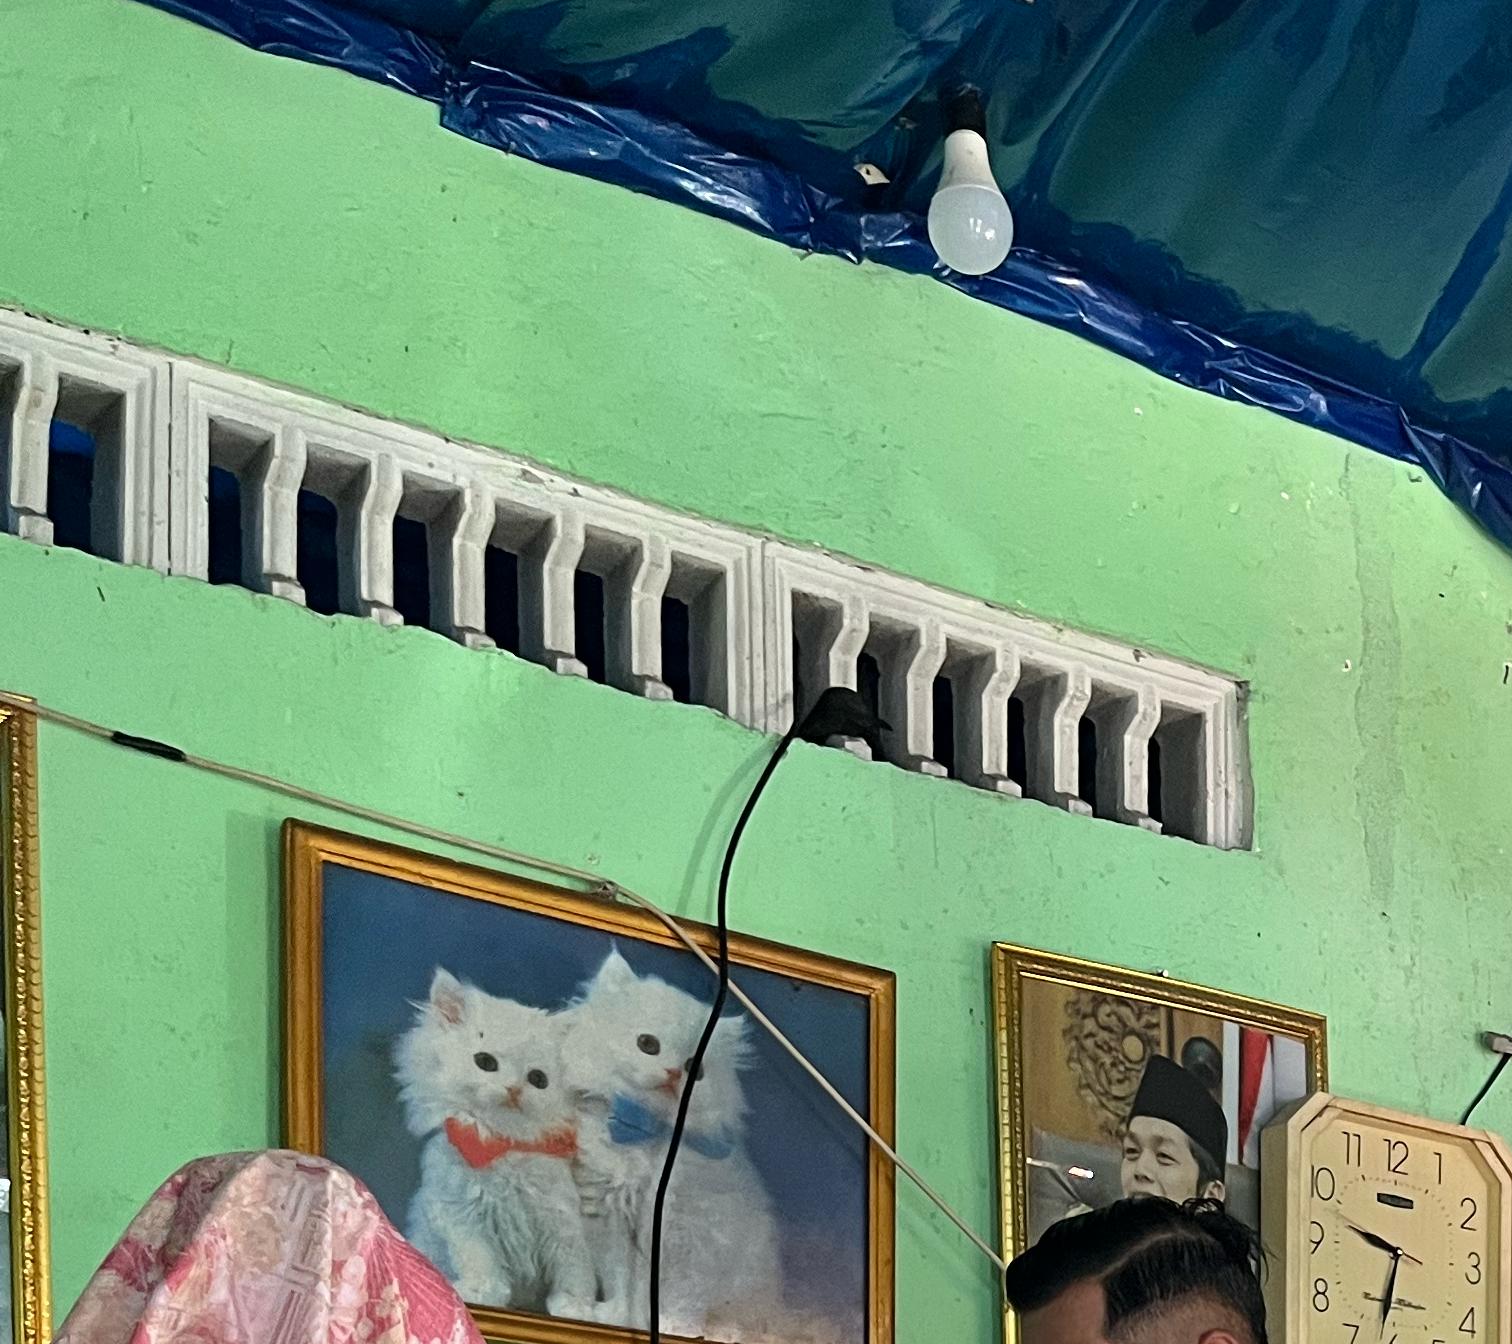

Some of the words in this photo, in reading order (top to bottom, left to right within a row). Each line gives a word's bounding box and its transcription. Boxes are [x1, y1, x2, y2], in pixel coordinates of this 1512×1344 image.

[1342, 1131, 1362, 1168] 11
[1383, 1138, 1410, 1175] 12
[1310, 1165, 1335, 1201] 10
[1433, 1152, 1443, 1185] 1
[1460, 1197, 1477, 1231] 2
[1310, 1220, 1325, 1255] 9
[1464, 1252, 1482, 1285] 3
[1312, 1277, 1329, 1313] 8
[1458, 1306, 1476, 1339] 4
